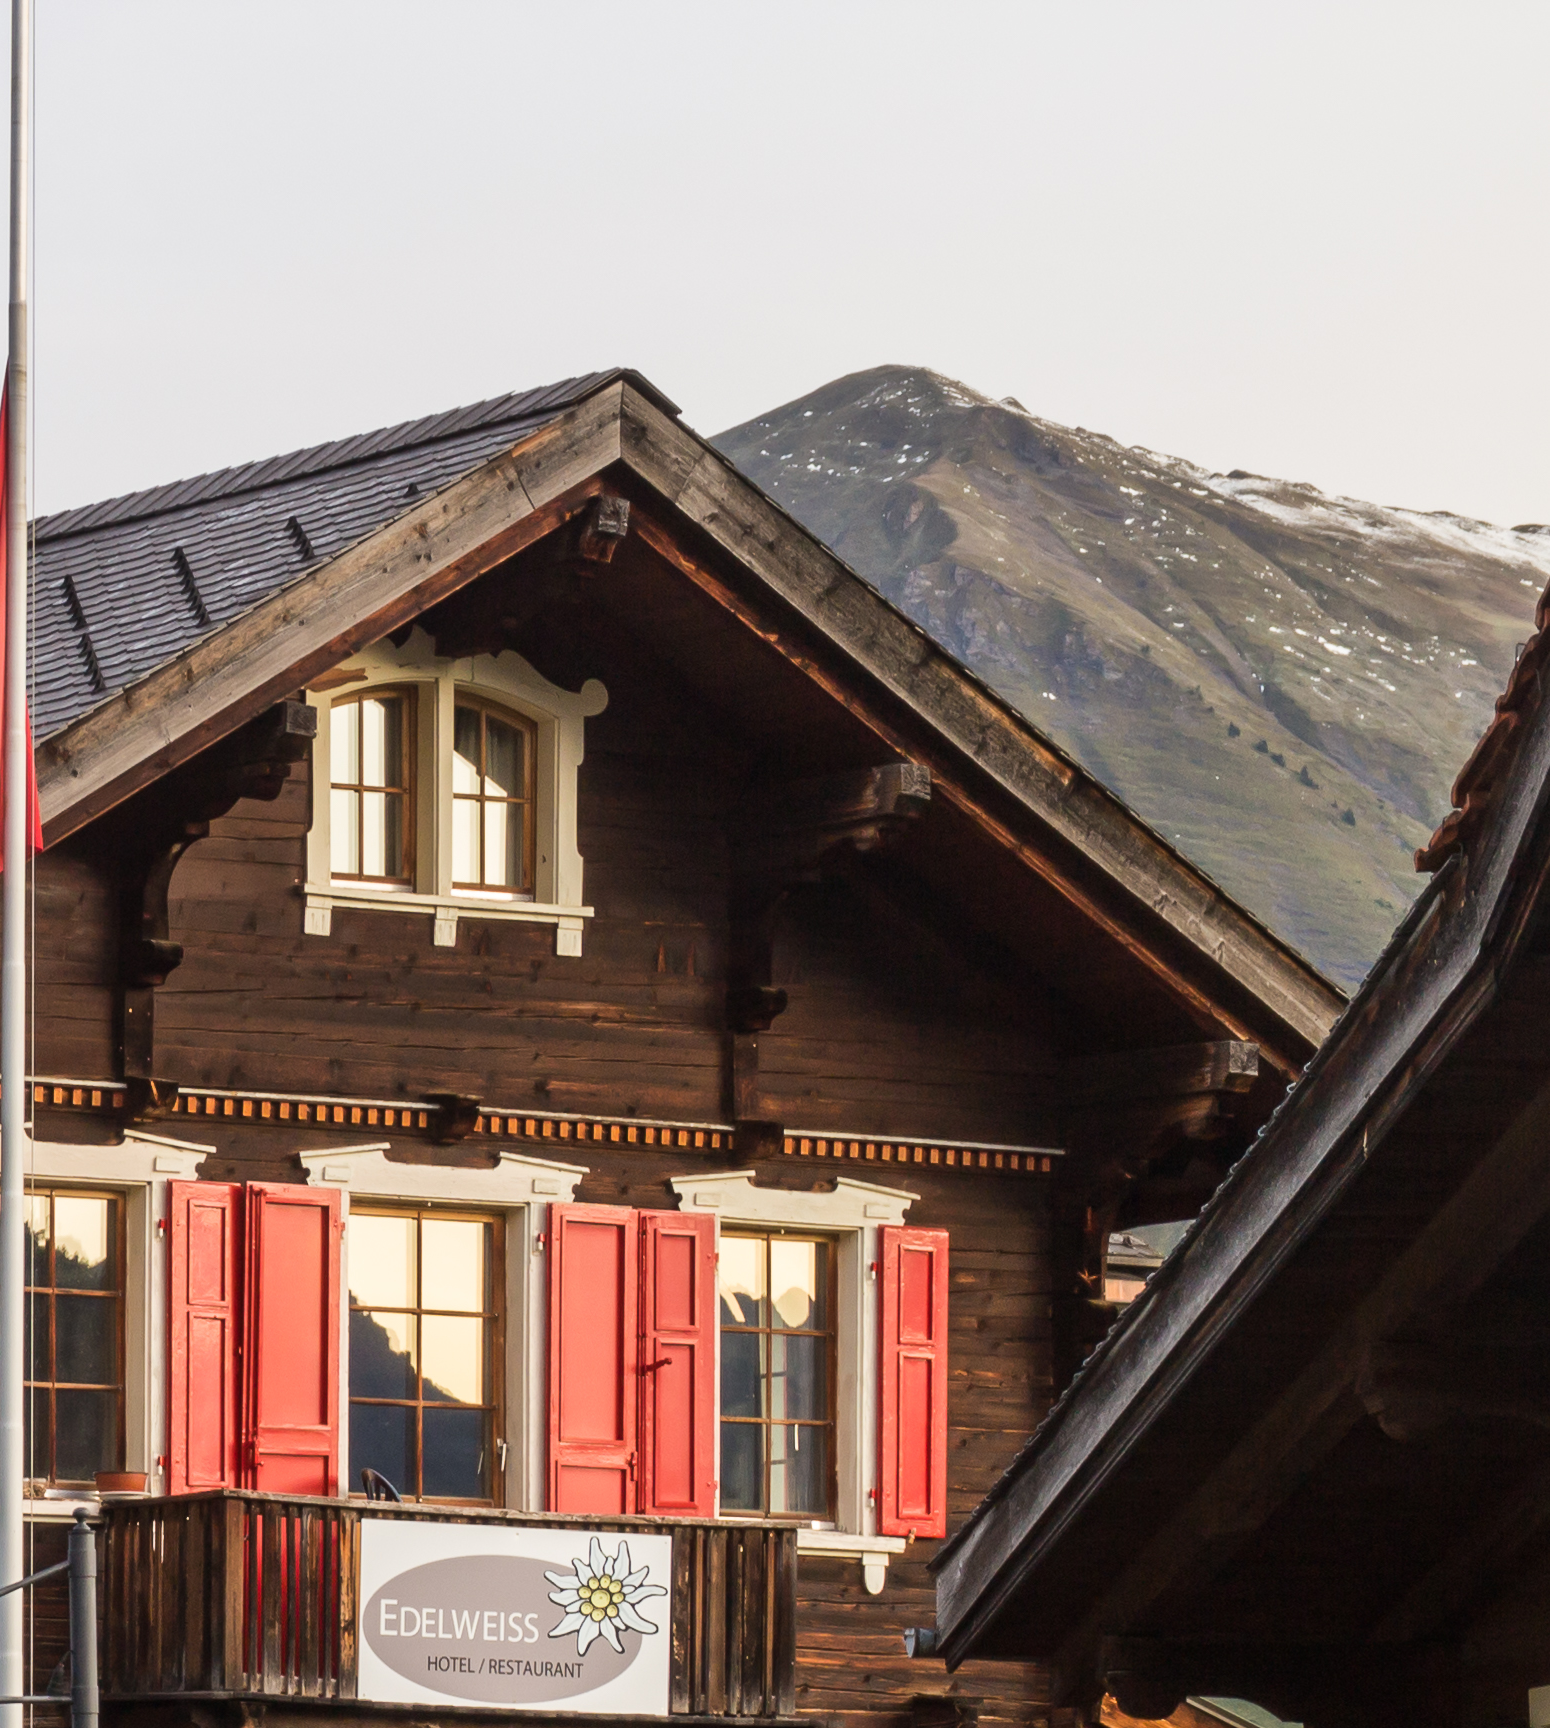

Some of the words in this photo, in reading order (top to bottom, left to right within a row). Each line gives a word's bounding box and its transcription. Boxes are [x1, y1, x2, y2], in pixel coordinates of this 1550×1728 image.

[379, 1597, 540, 1644] EDELWEISS
[426, 1655, 476, 1674] HOTEL
[488, 1657, 584, 1679] RESTAURANT
